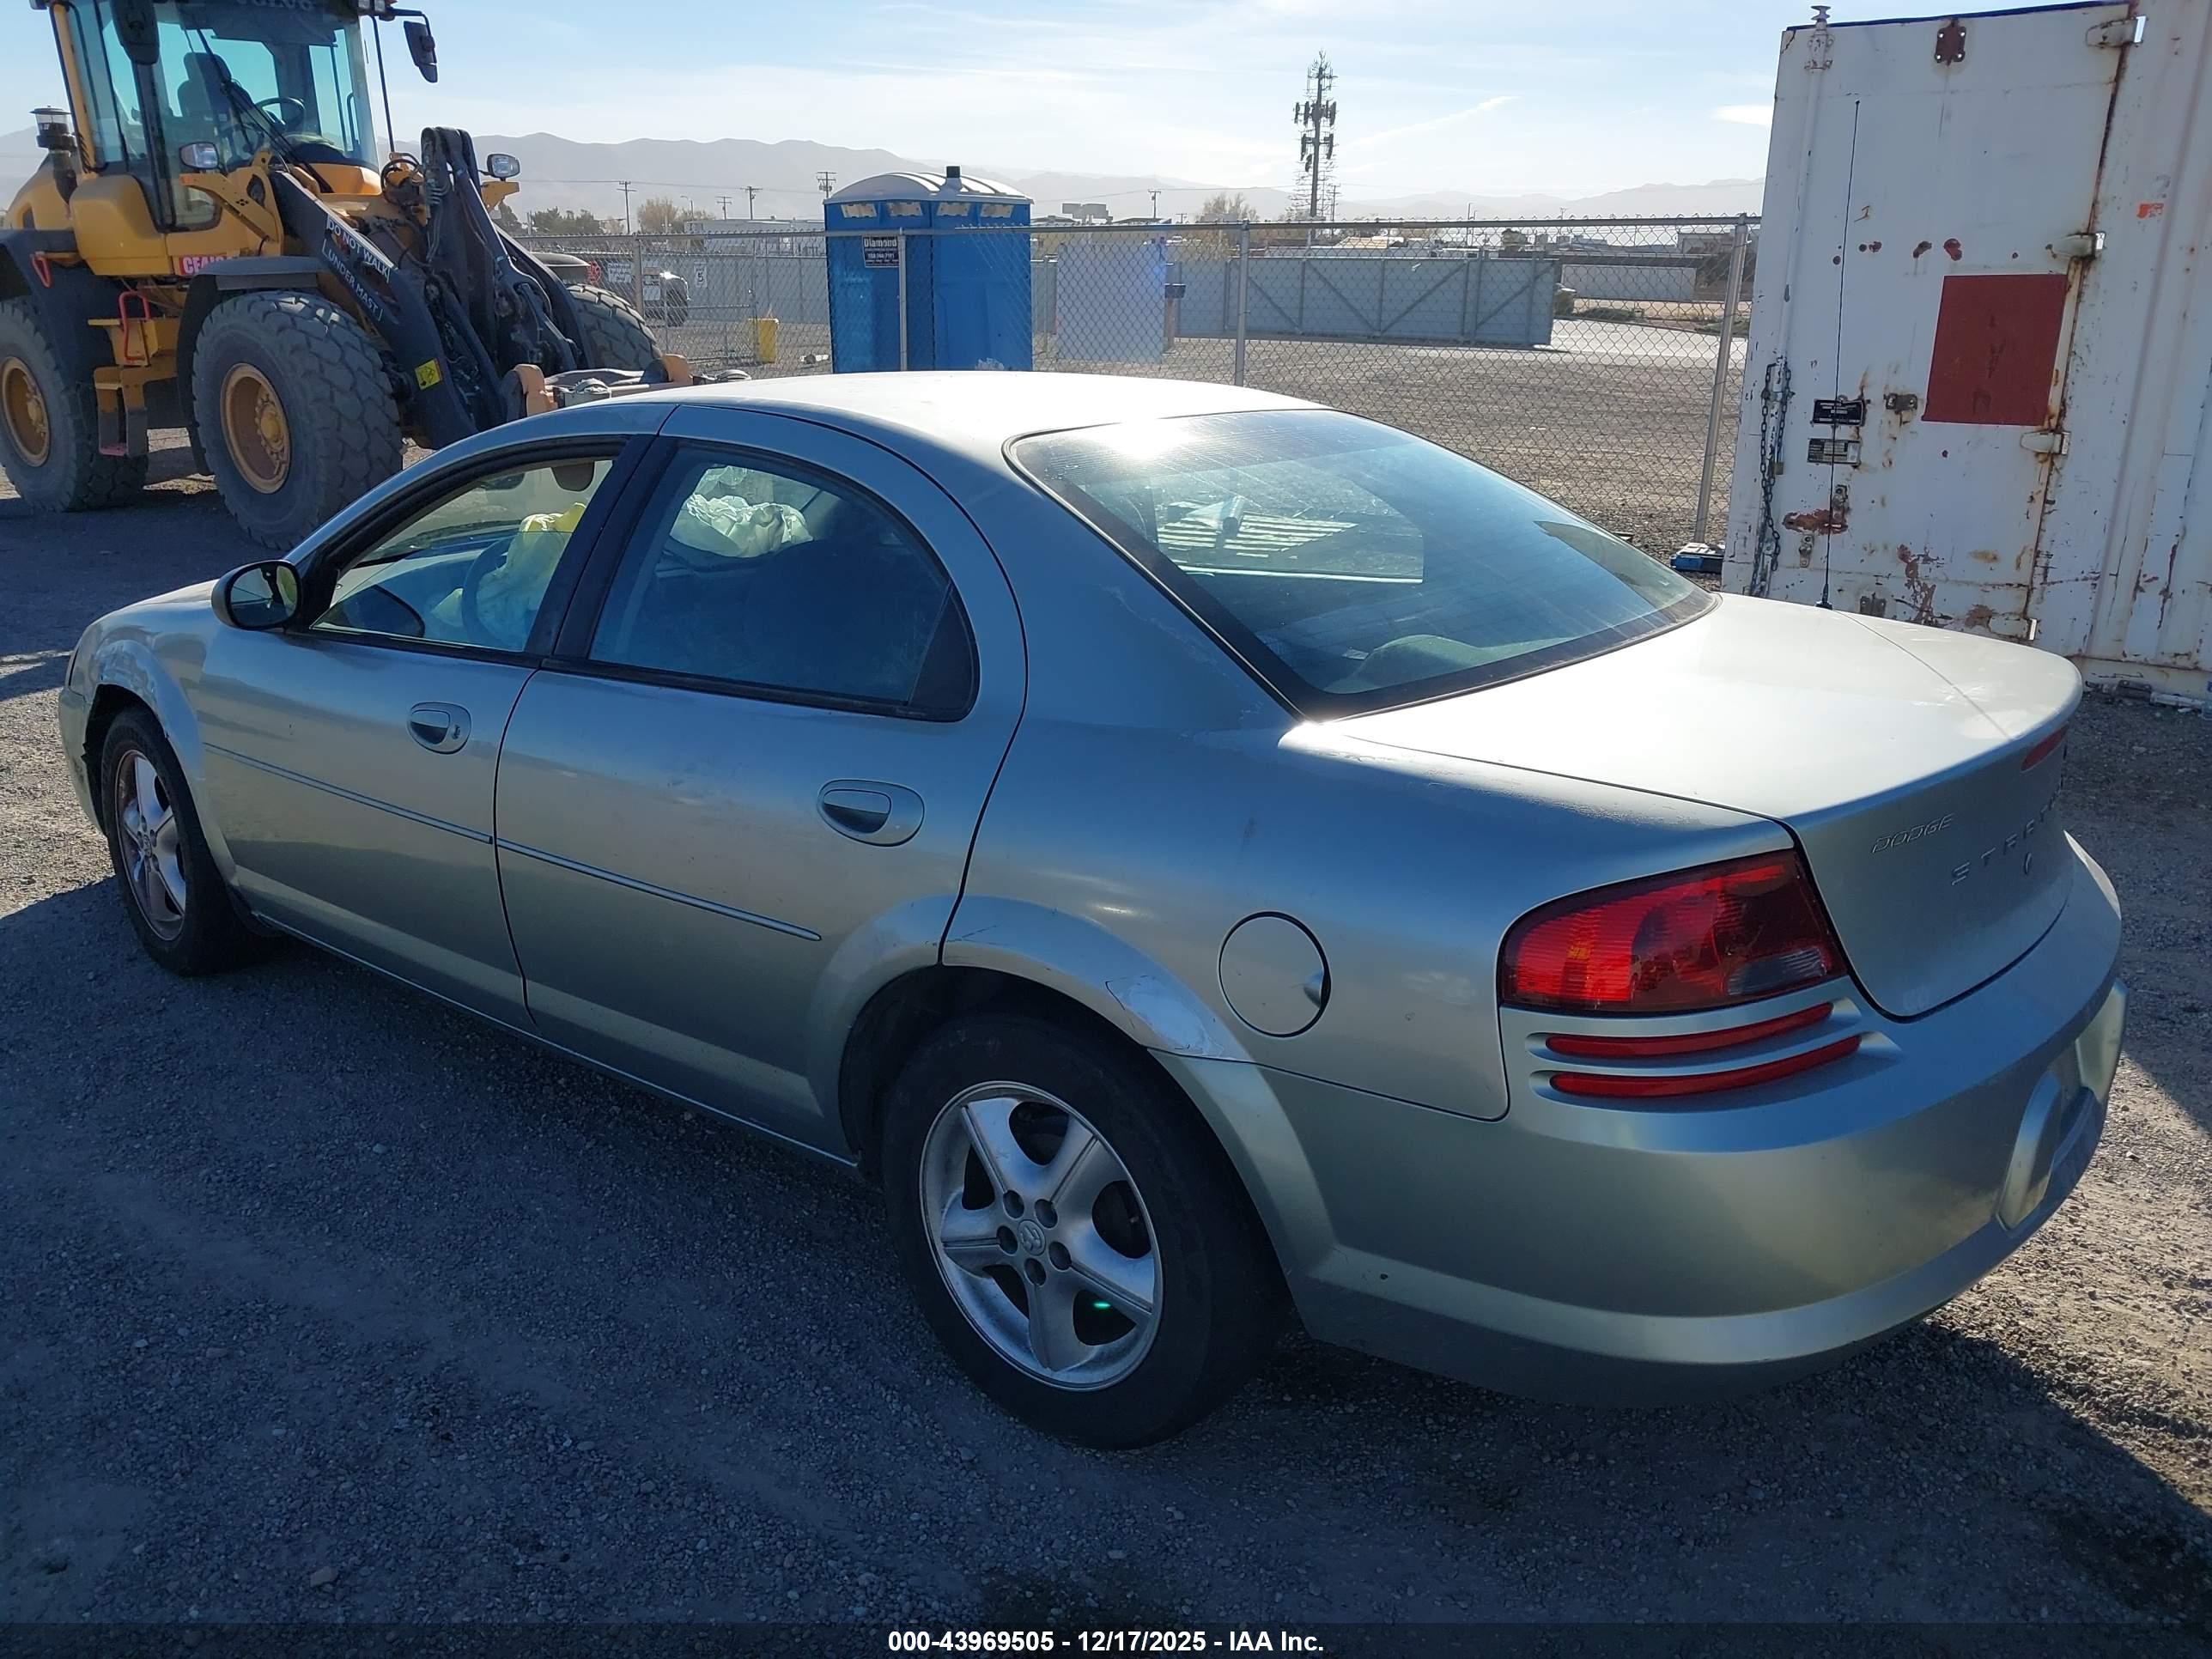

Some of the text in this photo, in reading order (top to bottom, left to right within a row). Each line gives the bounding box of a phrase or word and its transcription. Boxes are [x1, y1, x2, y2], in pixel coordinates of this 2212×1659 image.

[328, 219, 390, 278] DO NOT WALK
[864, 237, 897, 248] Diamond
[328, 250, 379, 313] UNDER MAST
[1871, 812, 1955, 854] DODGE
